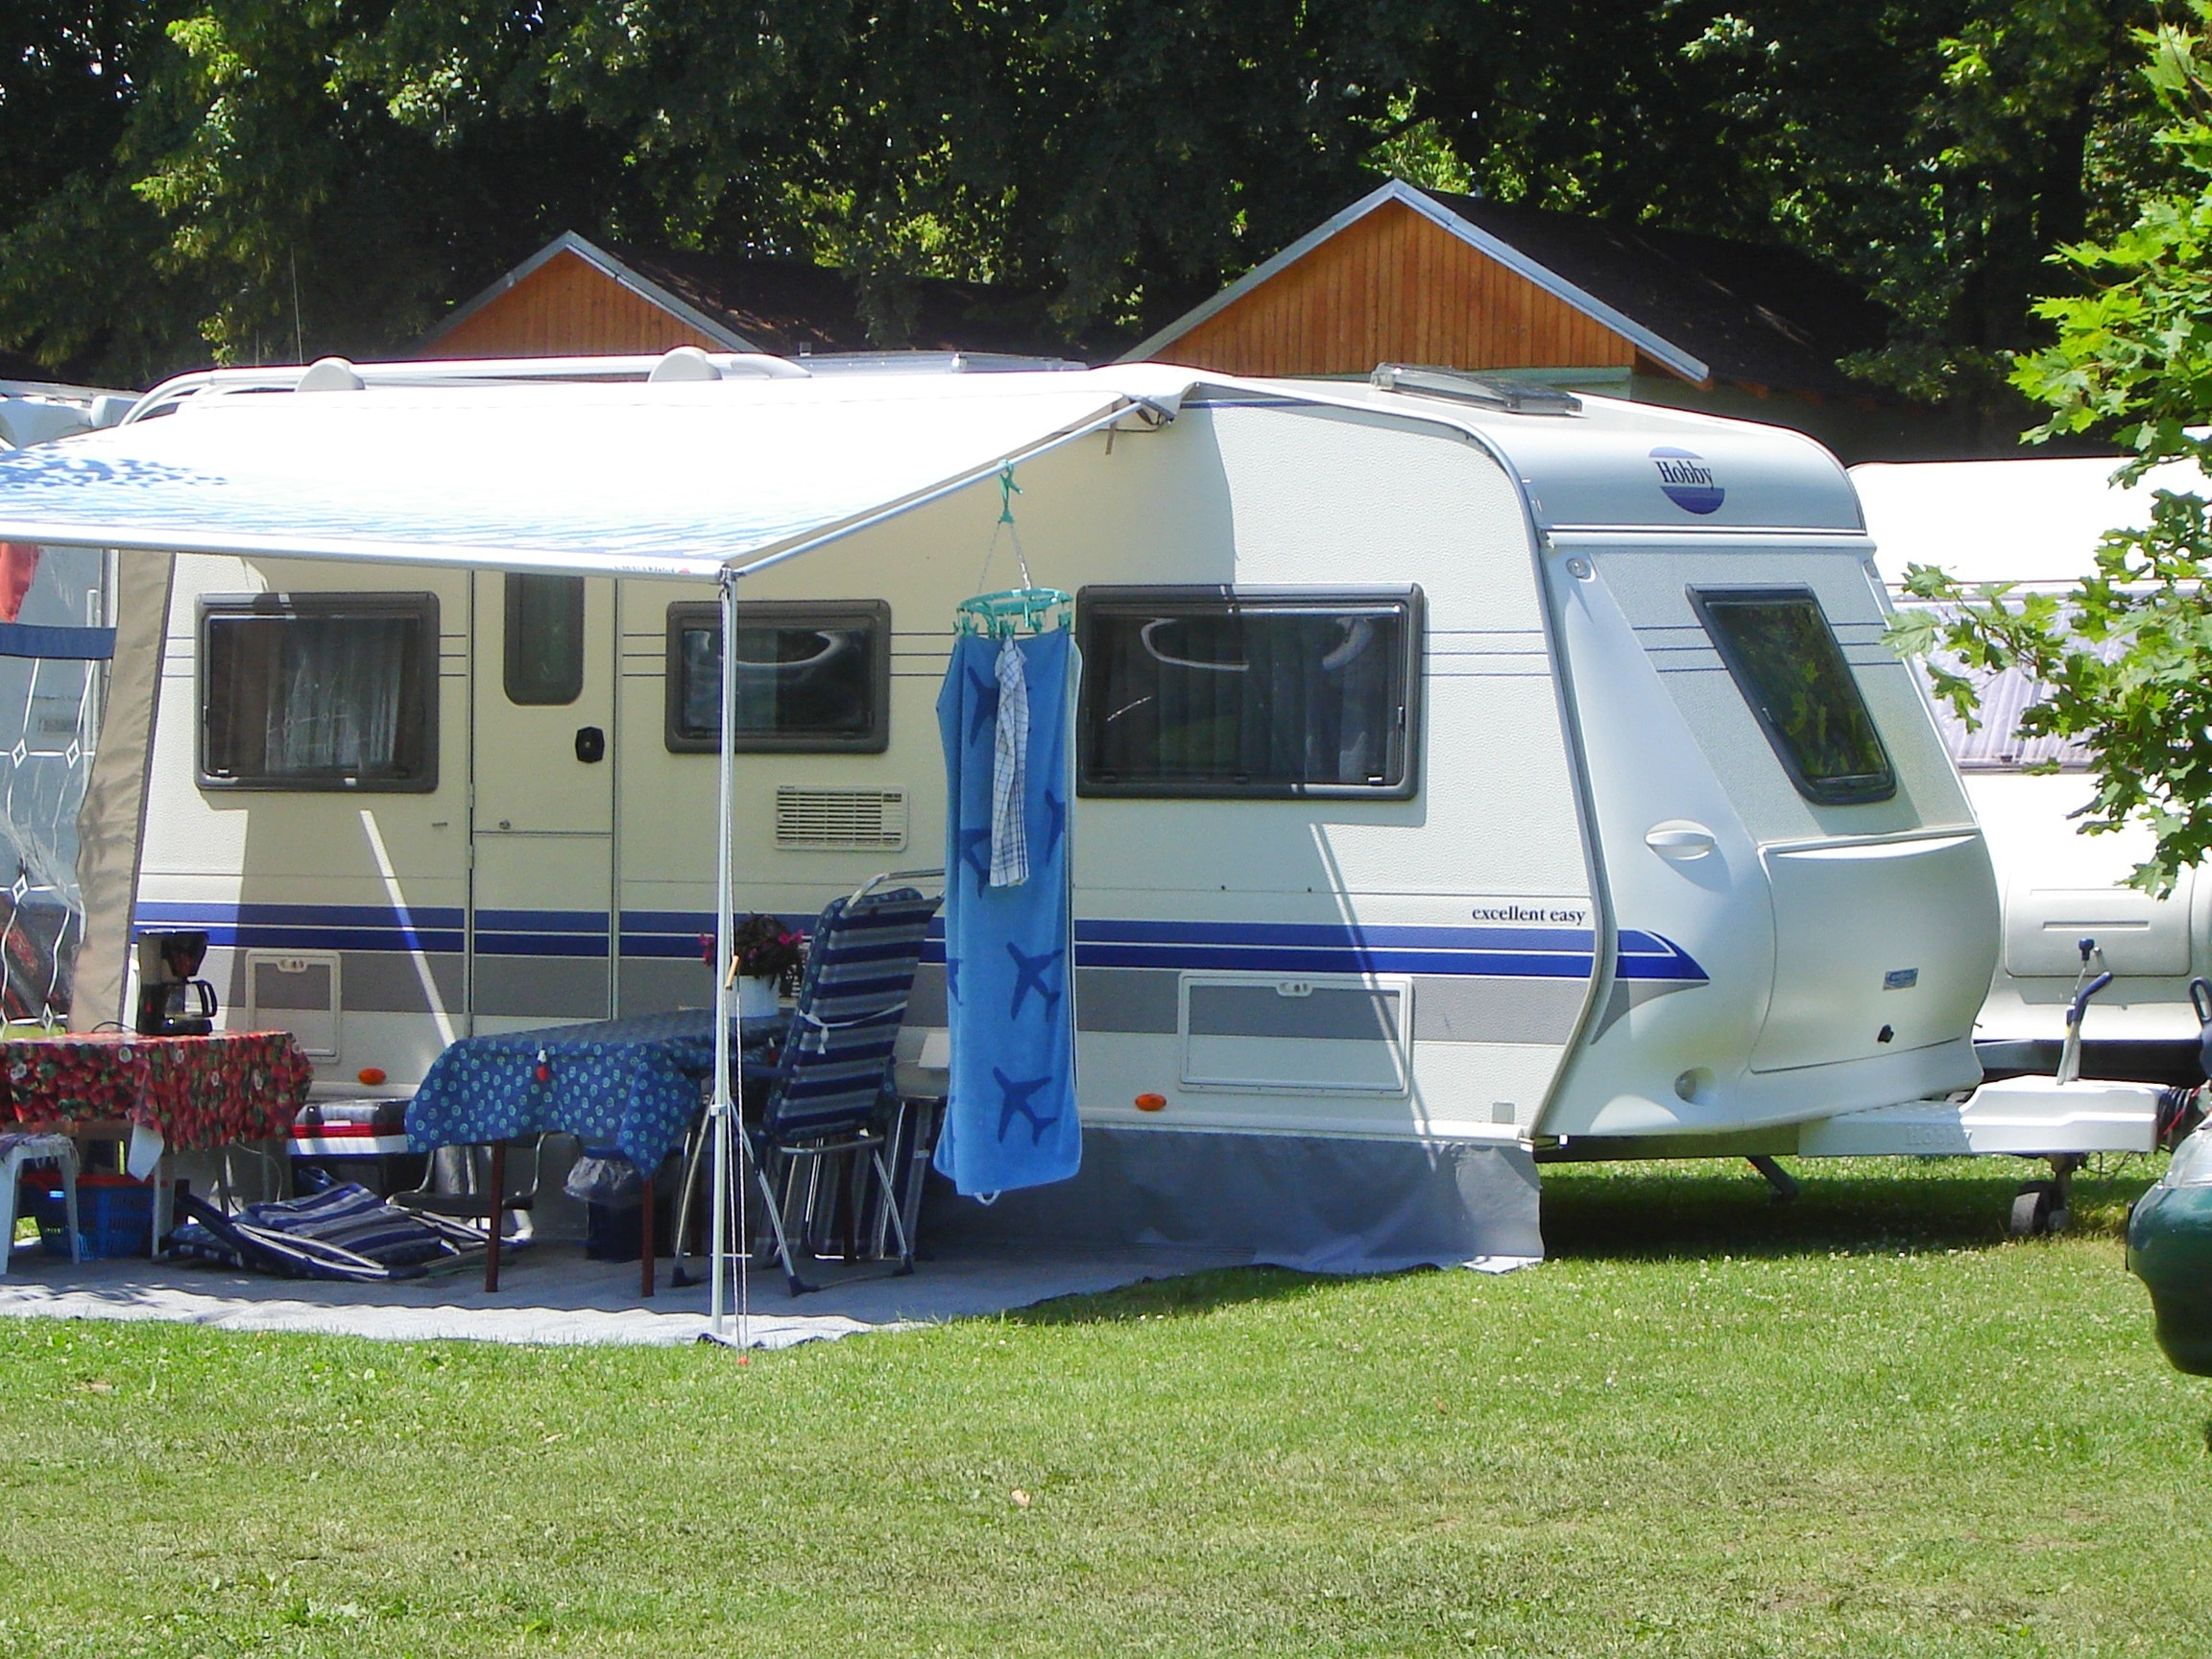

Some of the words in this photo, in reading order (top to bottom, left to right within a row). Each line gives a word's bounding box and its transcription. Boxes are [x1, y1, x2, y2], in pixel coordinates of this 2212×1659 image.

[1654, 460, 1714, 491] Hobby
[1472, 905, 1545, 922] excellent
[1550, 910, 1586, 926] easy
